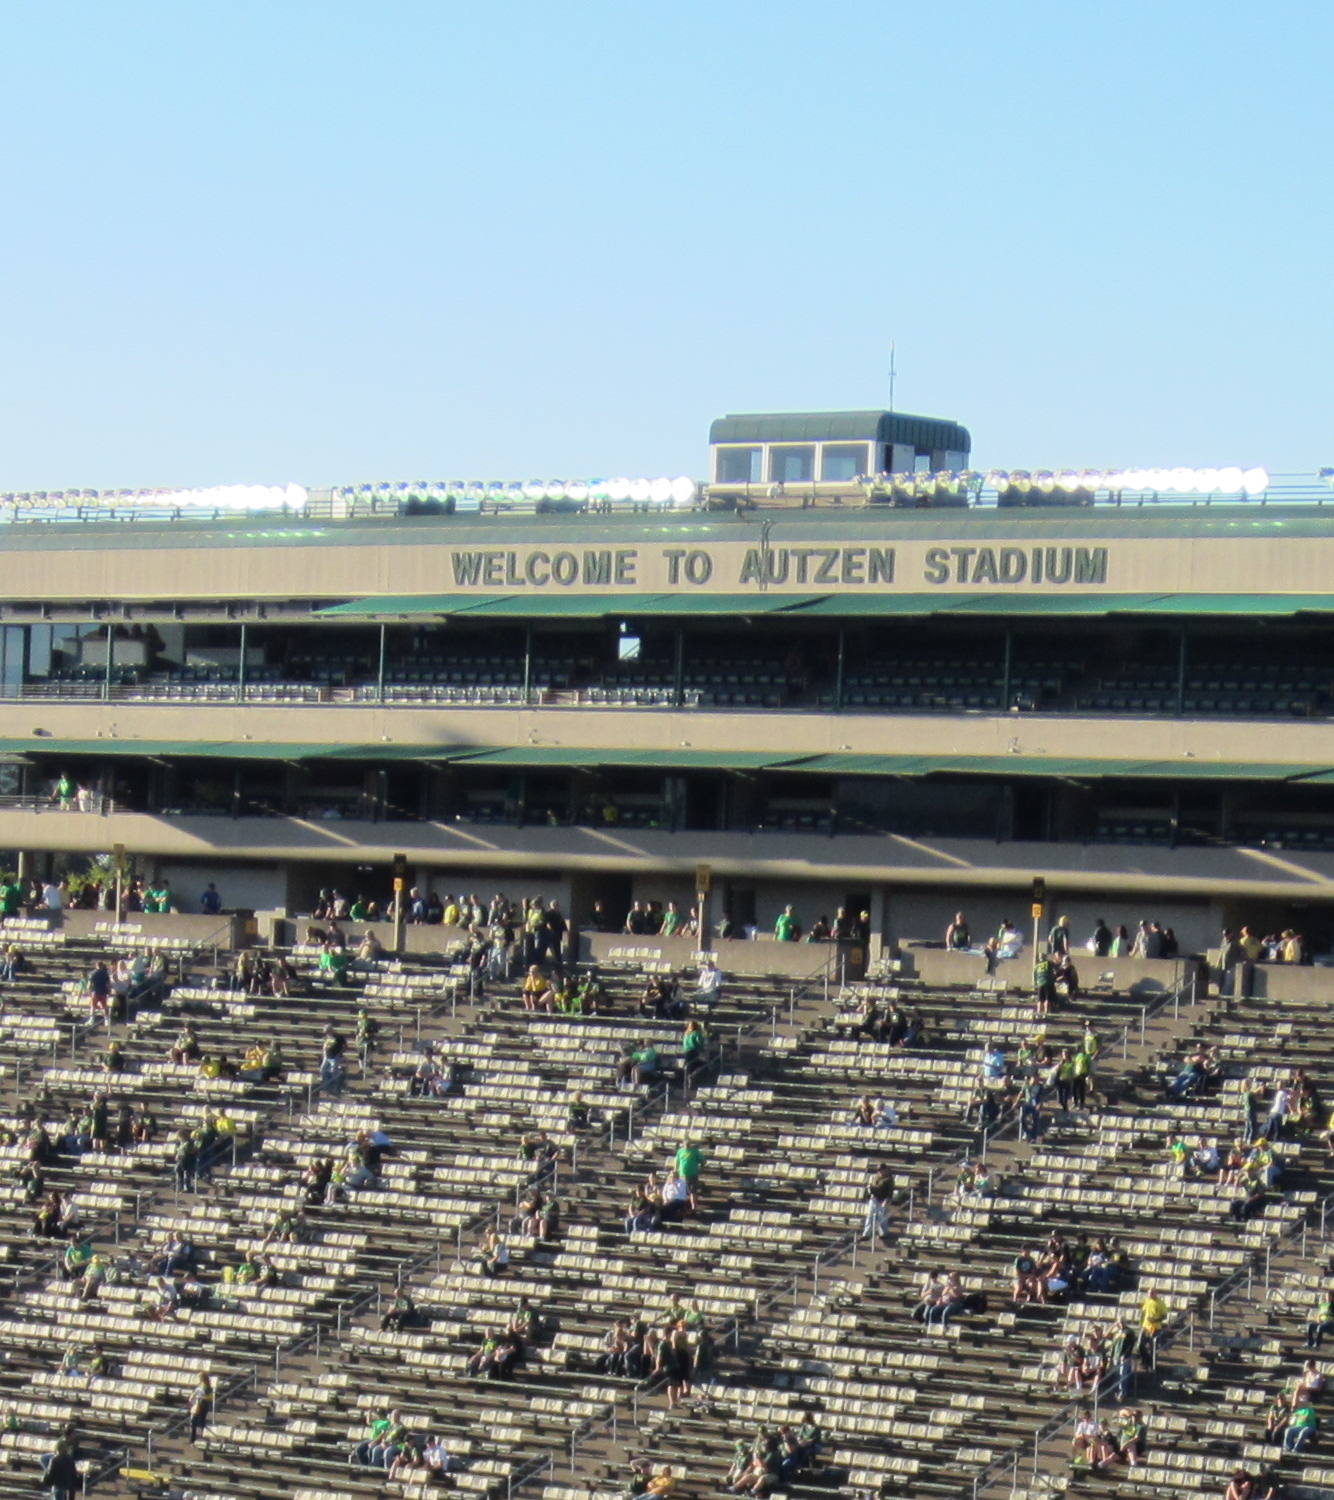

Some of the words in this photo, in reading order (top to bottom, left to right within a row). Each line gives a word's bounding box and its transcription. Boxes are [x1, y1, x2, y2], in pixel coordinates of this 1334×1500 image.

[451, 549, 638, 585] WELCOME
[662, 549, 713, 584] TO
[738, 548, 896, 584] AUTZEN
[923, 547, 1109, 584] STADIUM
